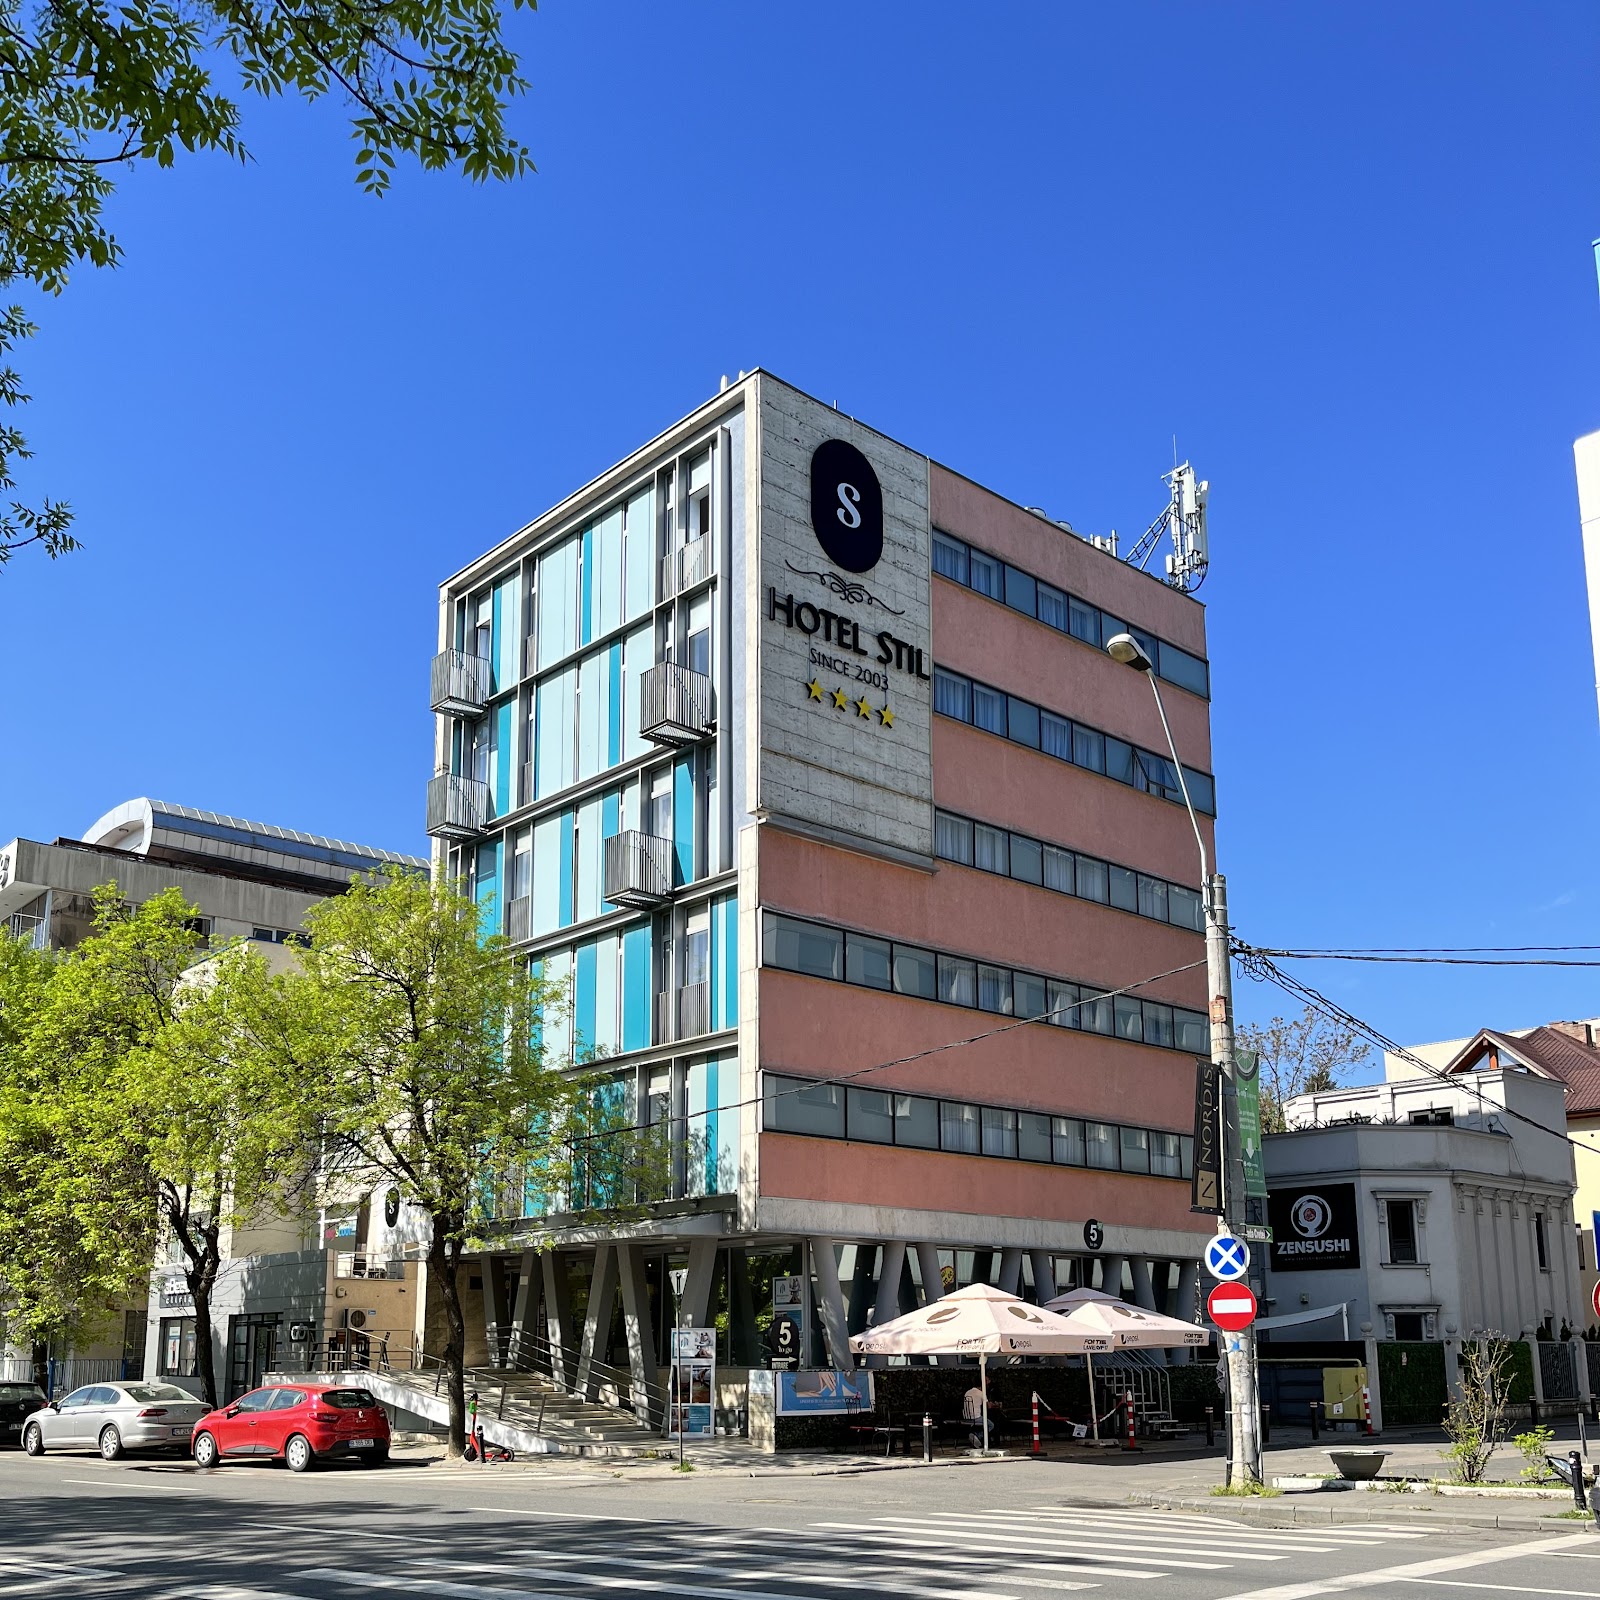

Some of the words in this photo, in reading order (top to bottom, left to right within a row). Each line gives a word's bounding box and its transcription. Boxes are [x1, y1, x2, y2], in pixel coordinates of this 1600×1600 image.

[836, 482, 861, 528] S
[769, 586, 868, 656] HOTEL
[877, 631, 931, 680] STIL
[809, 647, 850, 677] SINCE
[855, 664, 889, 690] 2003
[1089, 1224, 1098, 1242] 5
[1277, 1239, 1351, 1255] ZENSUSHI
[779, 1321, 792, 1346] 5
